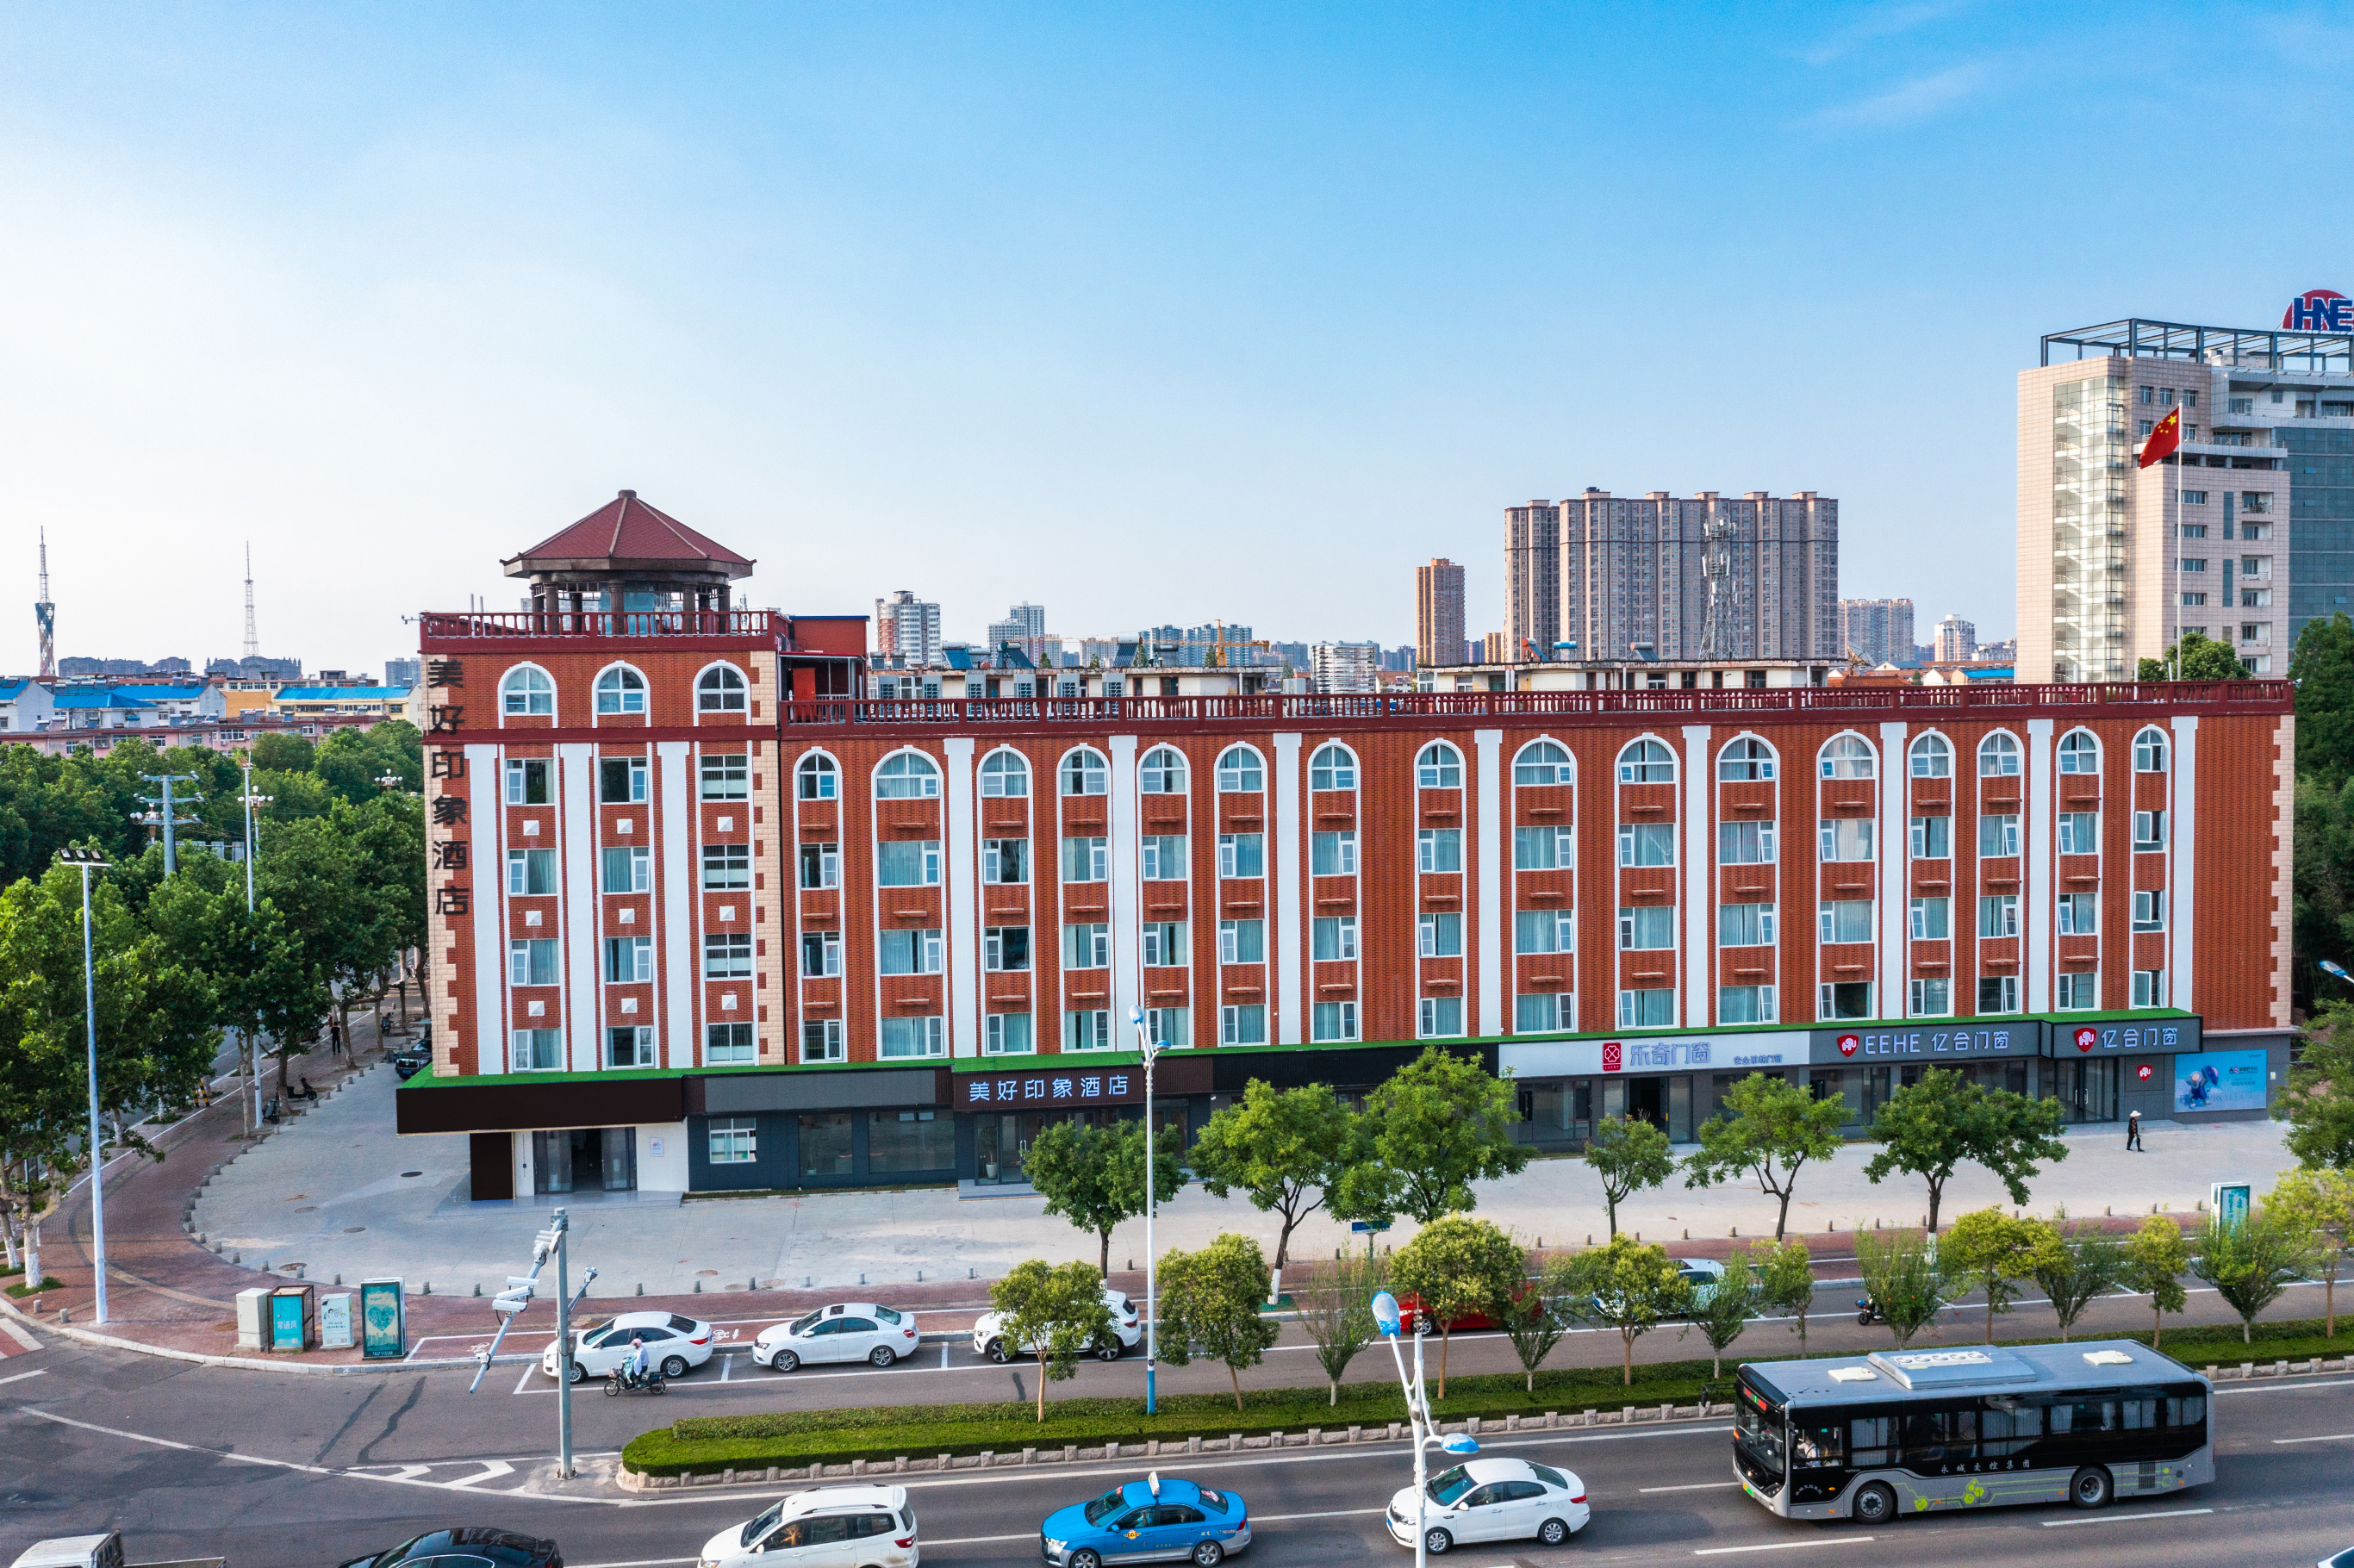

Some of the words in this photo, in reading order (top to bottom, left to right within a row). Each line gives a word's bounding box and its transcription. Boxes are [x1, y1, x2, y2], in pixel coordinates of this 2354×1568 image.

[2294, 297, 2353, 332] HNE
[428, 659, 470, 915] 美好印象酒店
[1865, 1033, 1921, 1055] EEHE
[1931, 1030, 2009, 1052] 亿合门窗
[2101, 1027, 2178, 1048] 亿合门窗
[1630, 1042, 1711, 1066] 乐奇门窗
[969, 1074, 1129, 1102] 美好印象酒店
